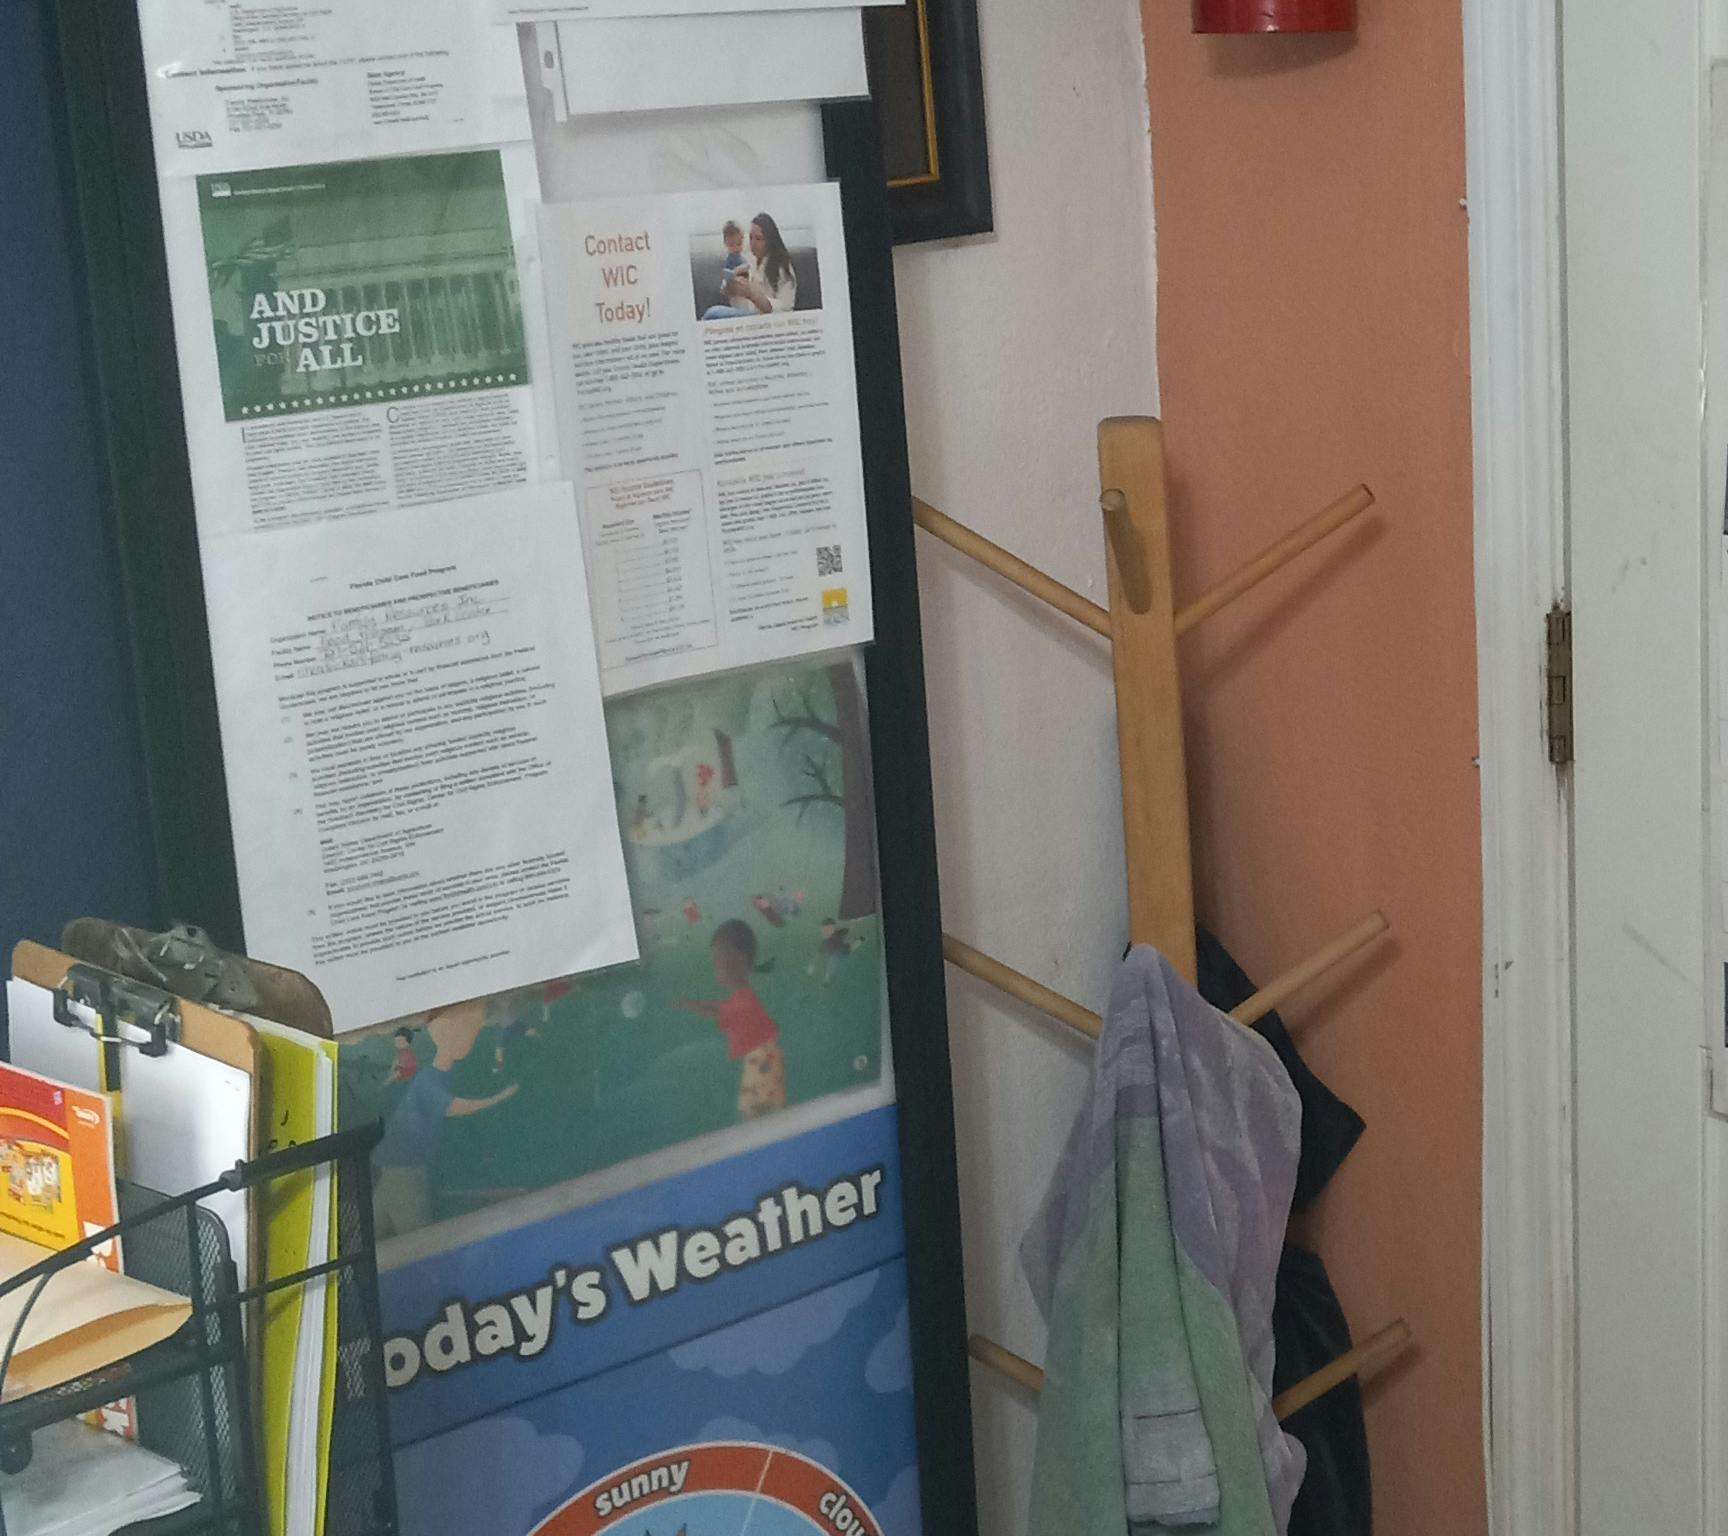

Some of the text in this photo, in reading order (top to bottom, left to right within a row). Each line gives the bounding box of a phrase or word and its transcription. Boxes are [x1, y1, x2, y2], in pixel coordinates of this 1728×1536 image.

[584, 230, 651, 256] Contact
[601, 265, 638, 288] WIC
[251, 288, 325, 319] AND
[595, 297, 651, 324] Today!
[252, 308, 399, 349] JUSTICE
[296, 343, 362, 372] ALL
[612, 1168, 882, 1302] Weather
[594, 1460, 690, 1518] sunny
